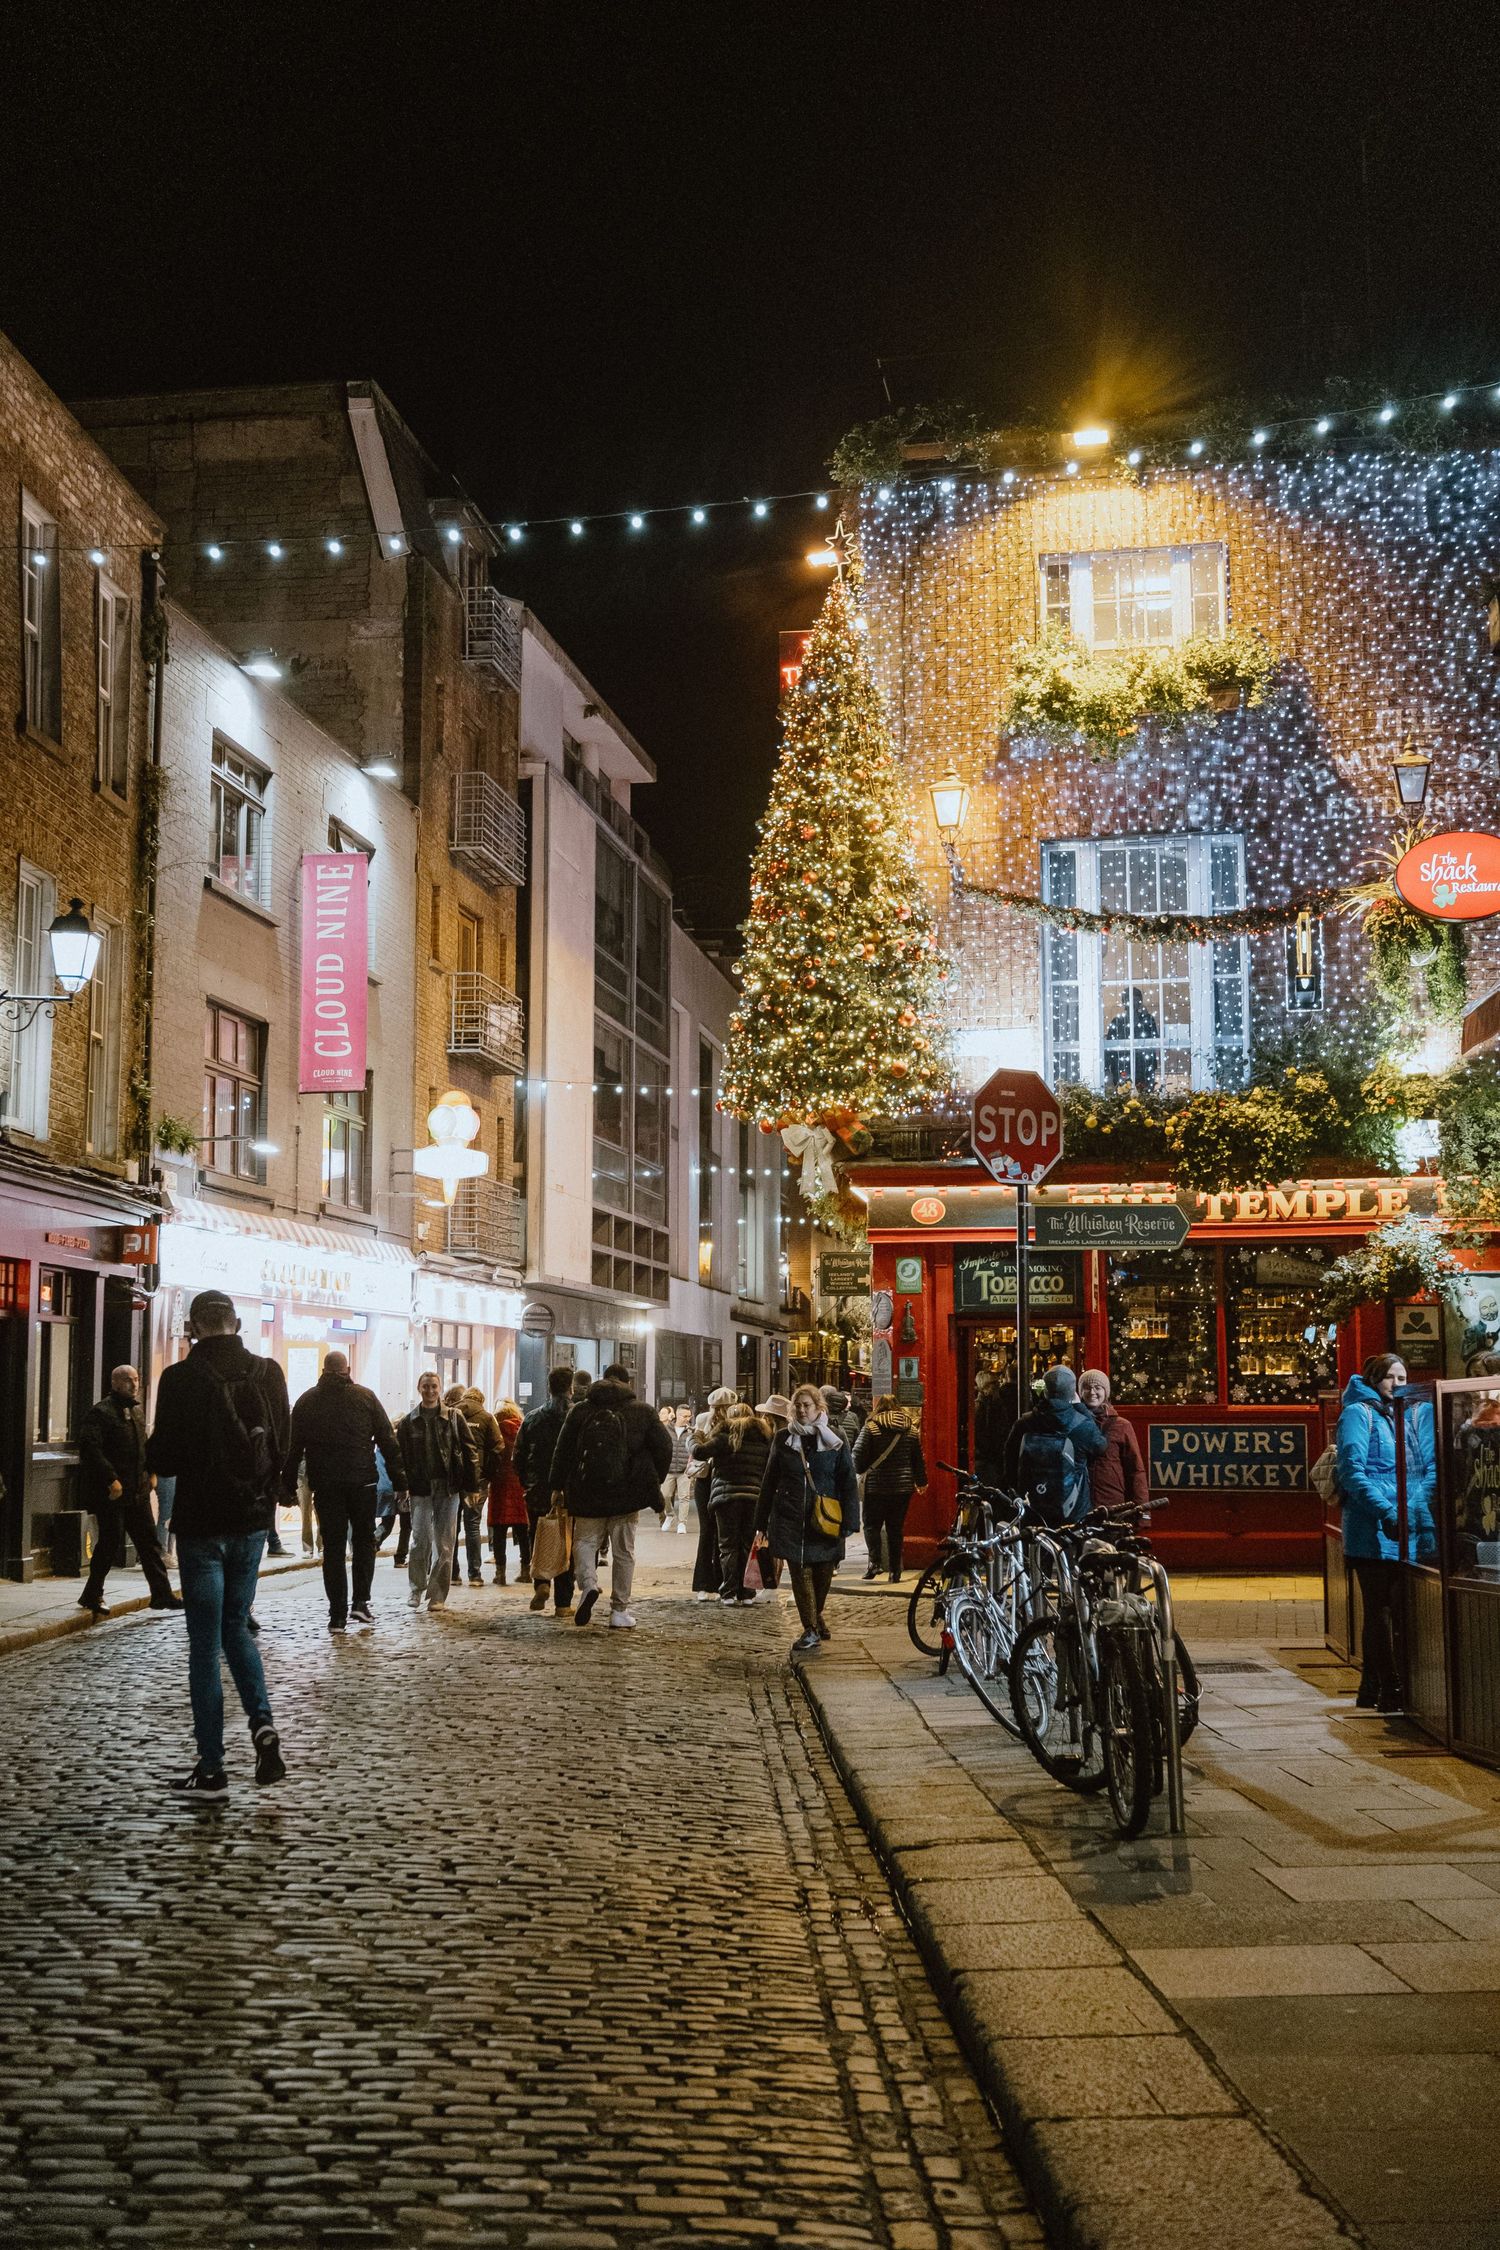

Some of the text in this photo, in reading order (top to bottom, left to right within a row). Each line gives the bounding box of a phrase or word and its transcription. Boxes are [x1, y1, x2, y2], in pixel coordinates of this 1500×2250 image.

[1440, 852, 1457, 865] The
[1420, 853, 1478, 893] Shack
[315, 863, 355, 940] NINE
[314, 953, 353, 1058] CLOUD
[313, 1069, 353, 1078] CLOUD NINE
[977, 1104, 1058, 1147] STOP
[918, 1202, 939, 1218] 48
[1195, 1188, 1411, 1222] TEMPLE
[1047, 1210, 1175, 1236] The Whiskey Reserve
[1003, 1264, 1063, 1273] FIN MOKING
[972, 1270, 1064, 1301] TOBCCO
[1043, 1295, 1071, 1303] Stock
[1161, 1428, 1295, 1454] POWER'S
[1152, 1461, 1303, 1487] WHISKEY
[1474, 1443, 1500, 1490] Shac
